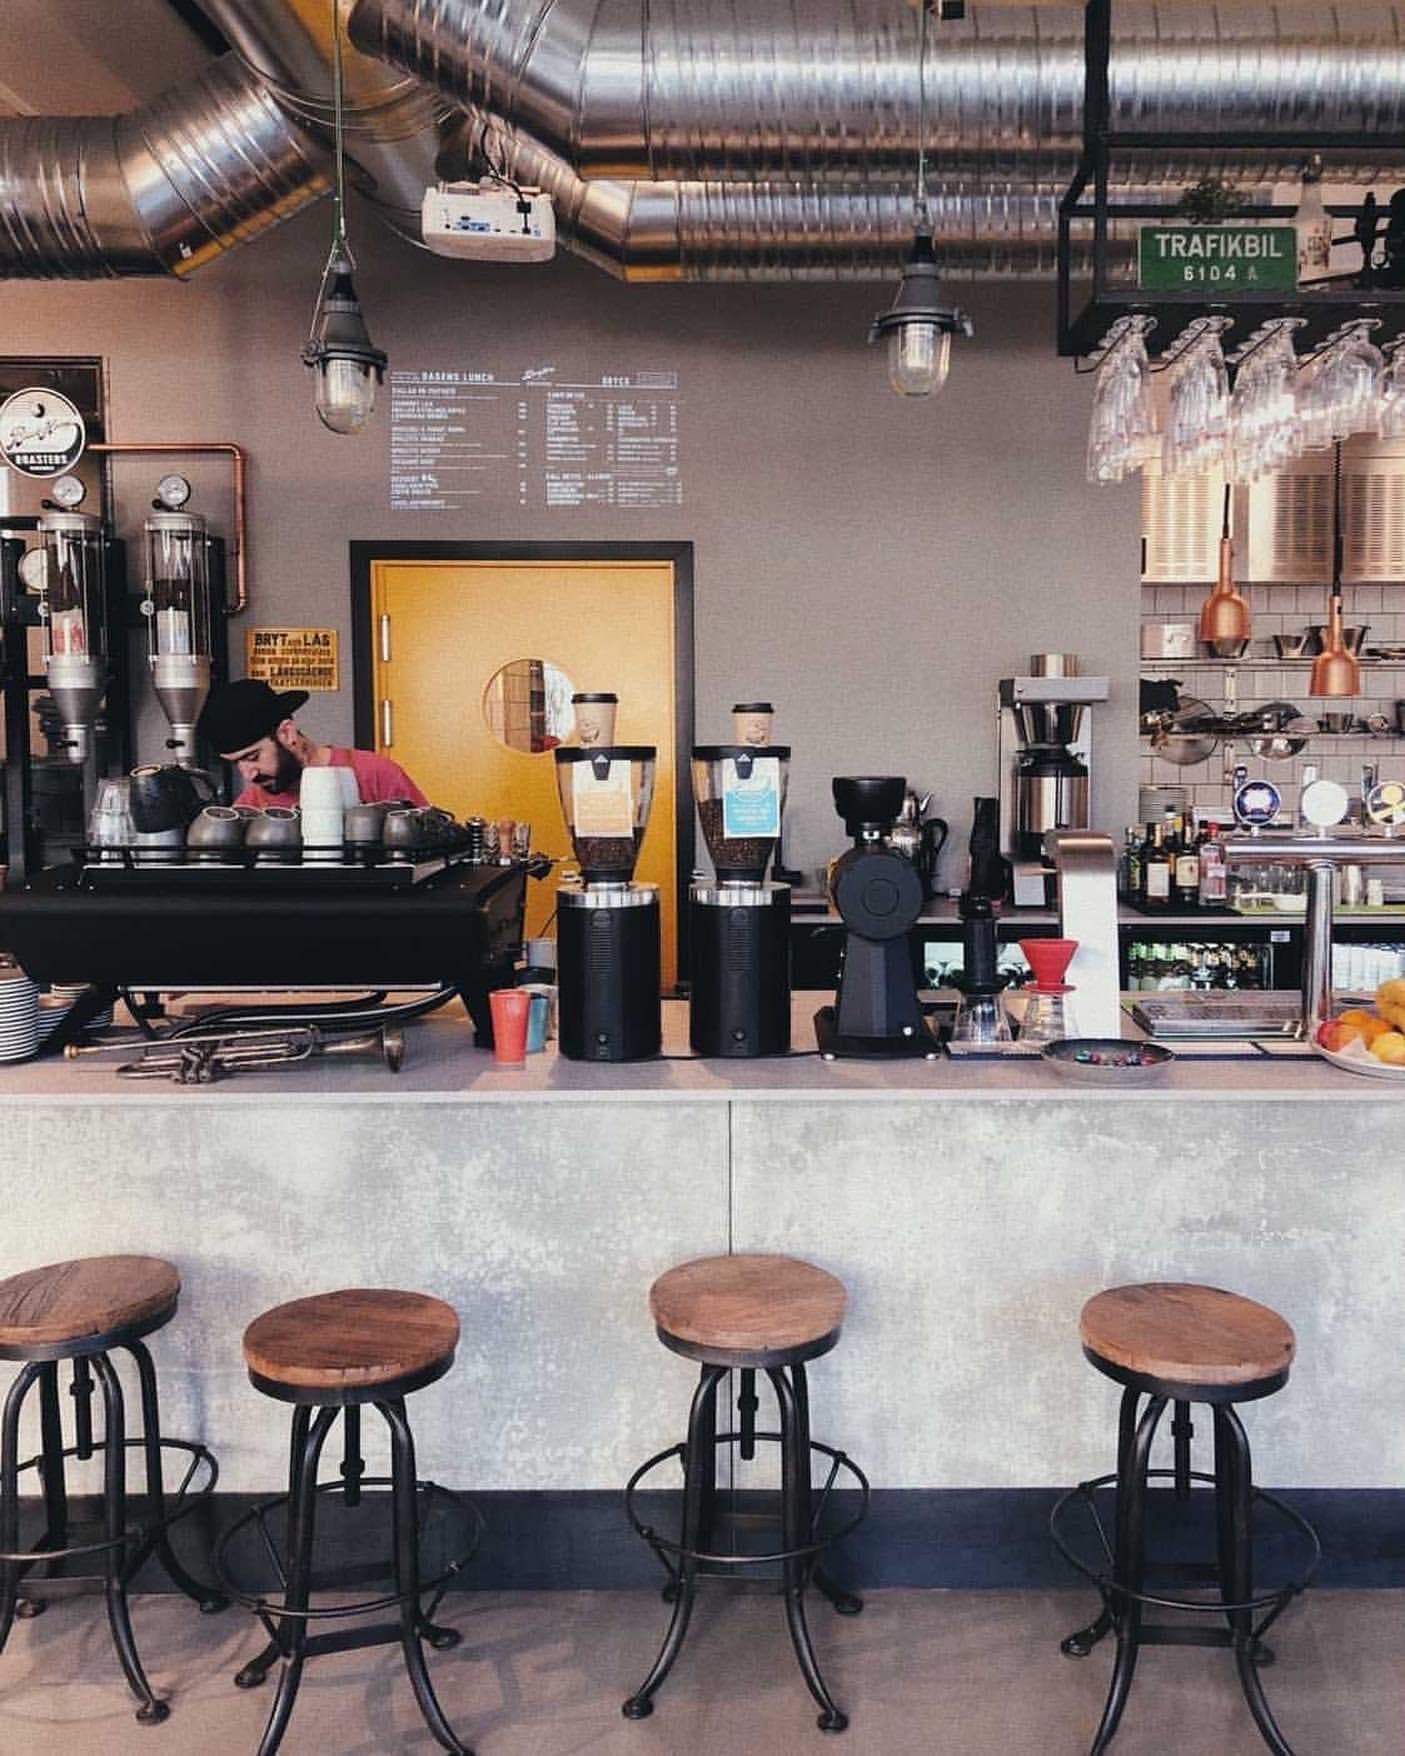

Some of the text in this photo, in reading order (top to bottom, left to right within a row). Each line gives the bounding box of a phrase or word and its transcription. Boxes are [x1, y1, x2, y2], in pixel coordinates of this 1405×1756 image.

[1155, 233, 1283, 257] TRAFIKBIL
[1184, 265, 1236, 281] 6104
[255, 632, 288, 647] BRYT
